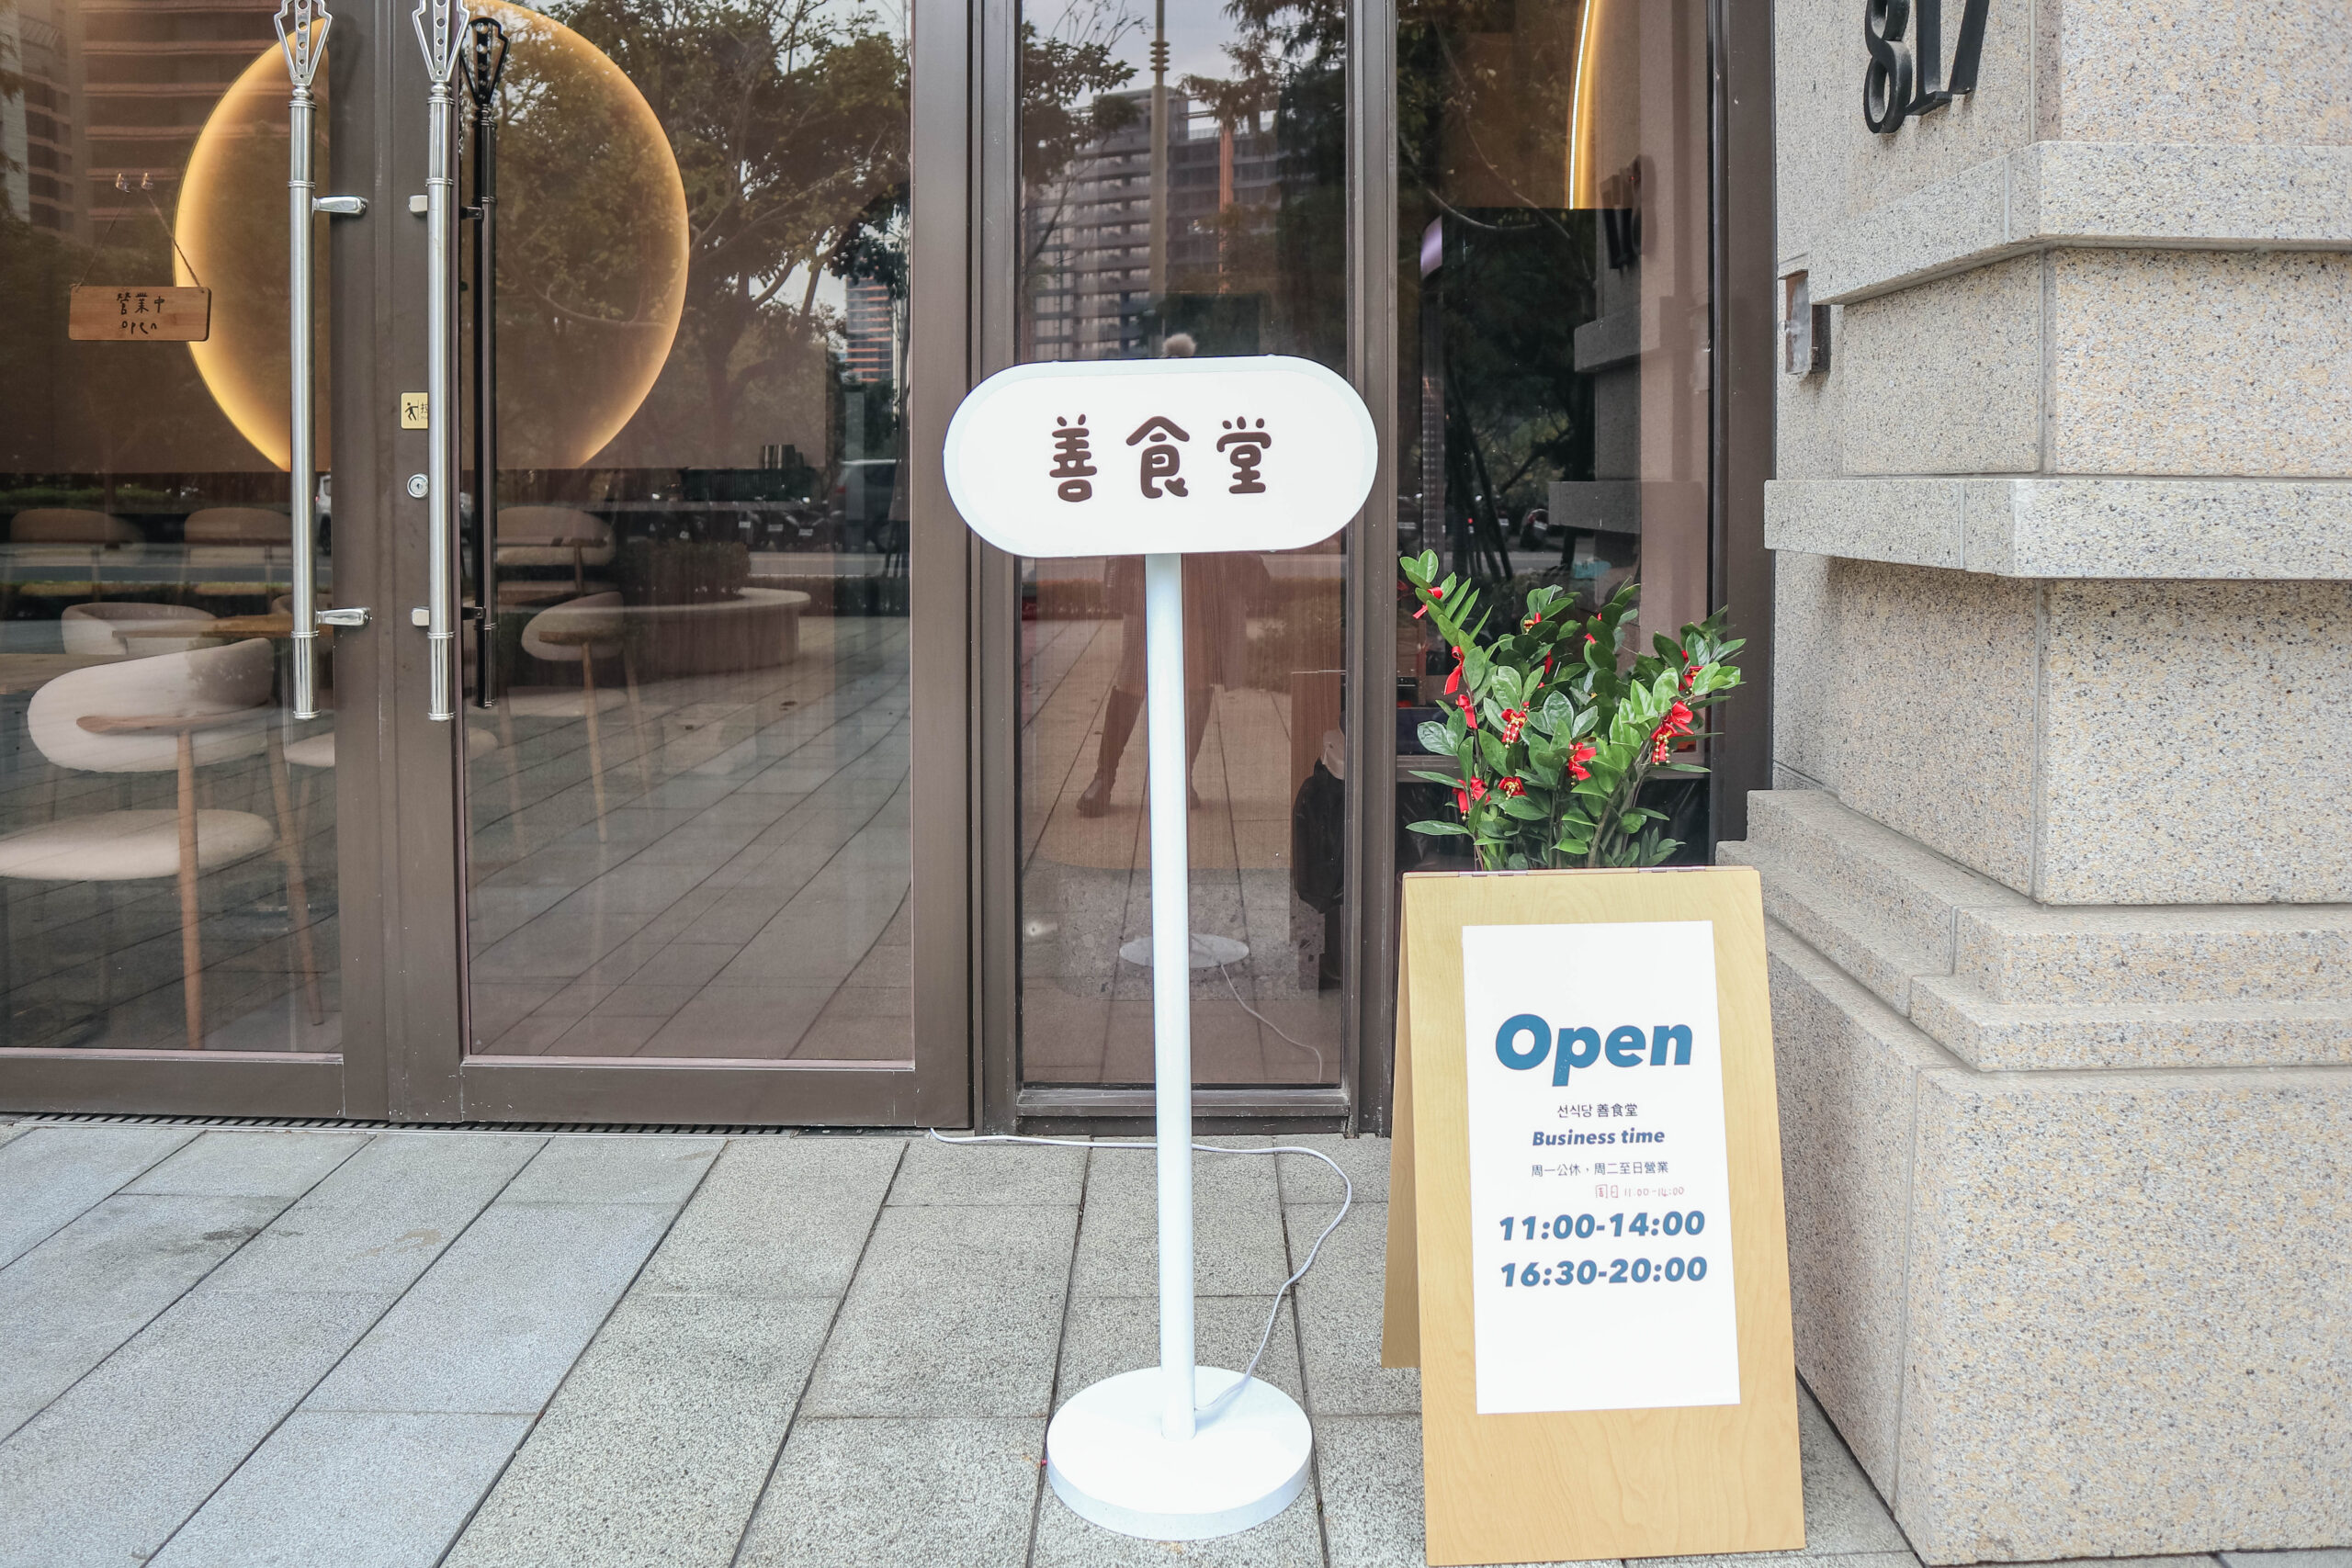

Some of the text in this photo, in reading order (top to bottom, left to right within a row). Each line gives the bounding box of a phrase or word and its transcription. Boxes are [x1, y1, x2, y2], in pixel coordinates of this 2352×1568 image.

[116, 291, 165, 315] 營業中
[1049, 413, 1272, 503] 善食堂
[1495, 1013, 1694, 1088] Open
[1557, 1102, 1638, 1119] 선식당 善食堂
[1532, 1127, 1666, 1146] Business time
[1499, 1210, 1706, 1241] 11:00-14:00
[1500, 1256, 1709, 1288] 16:30-20:00
